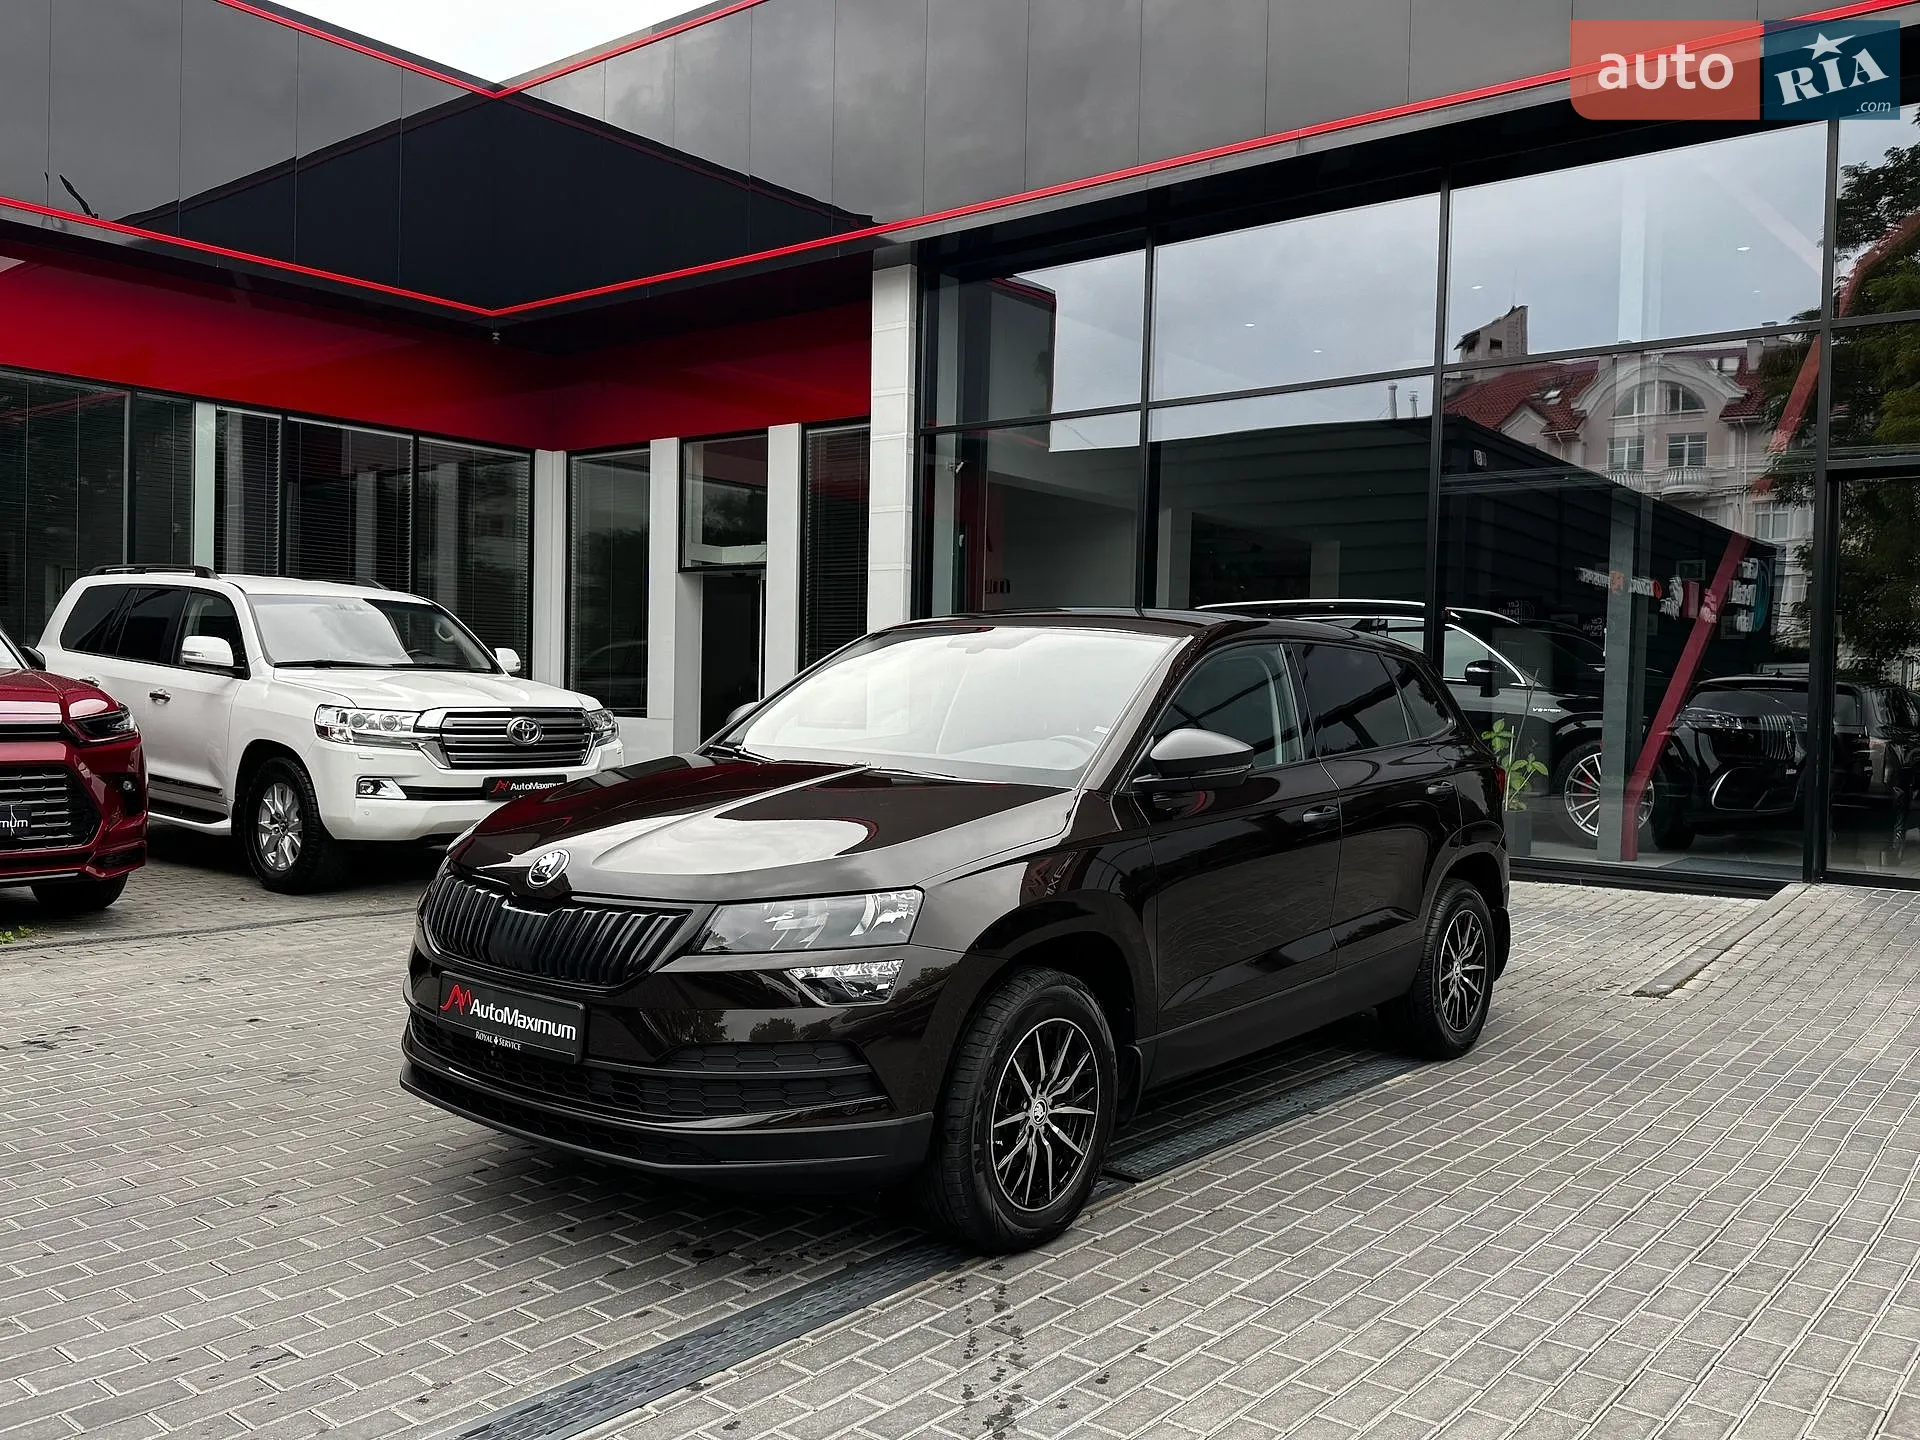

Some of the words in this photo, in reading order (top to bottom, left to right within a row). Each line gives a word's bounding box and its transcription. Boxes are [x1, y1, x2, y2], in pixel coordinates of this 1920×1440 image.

[470, 998, 577, 1041] AutoMaximum
[475, 1030, 494, 1044] ROYAL
[498, 1037, 522, 1051] SERVICE
